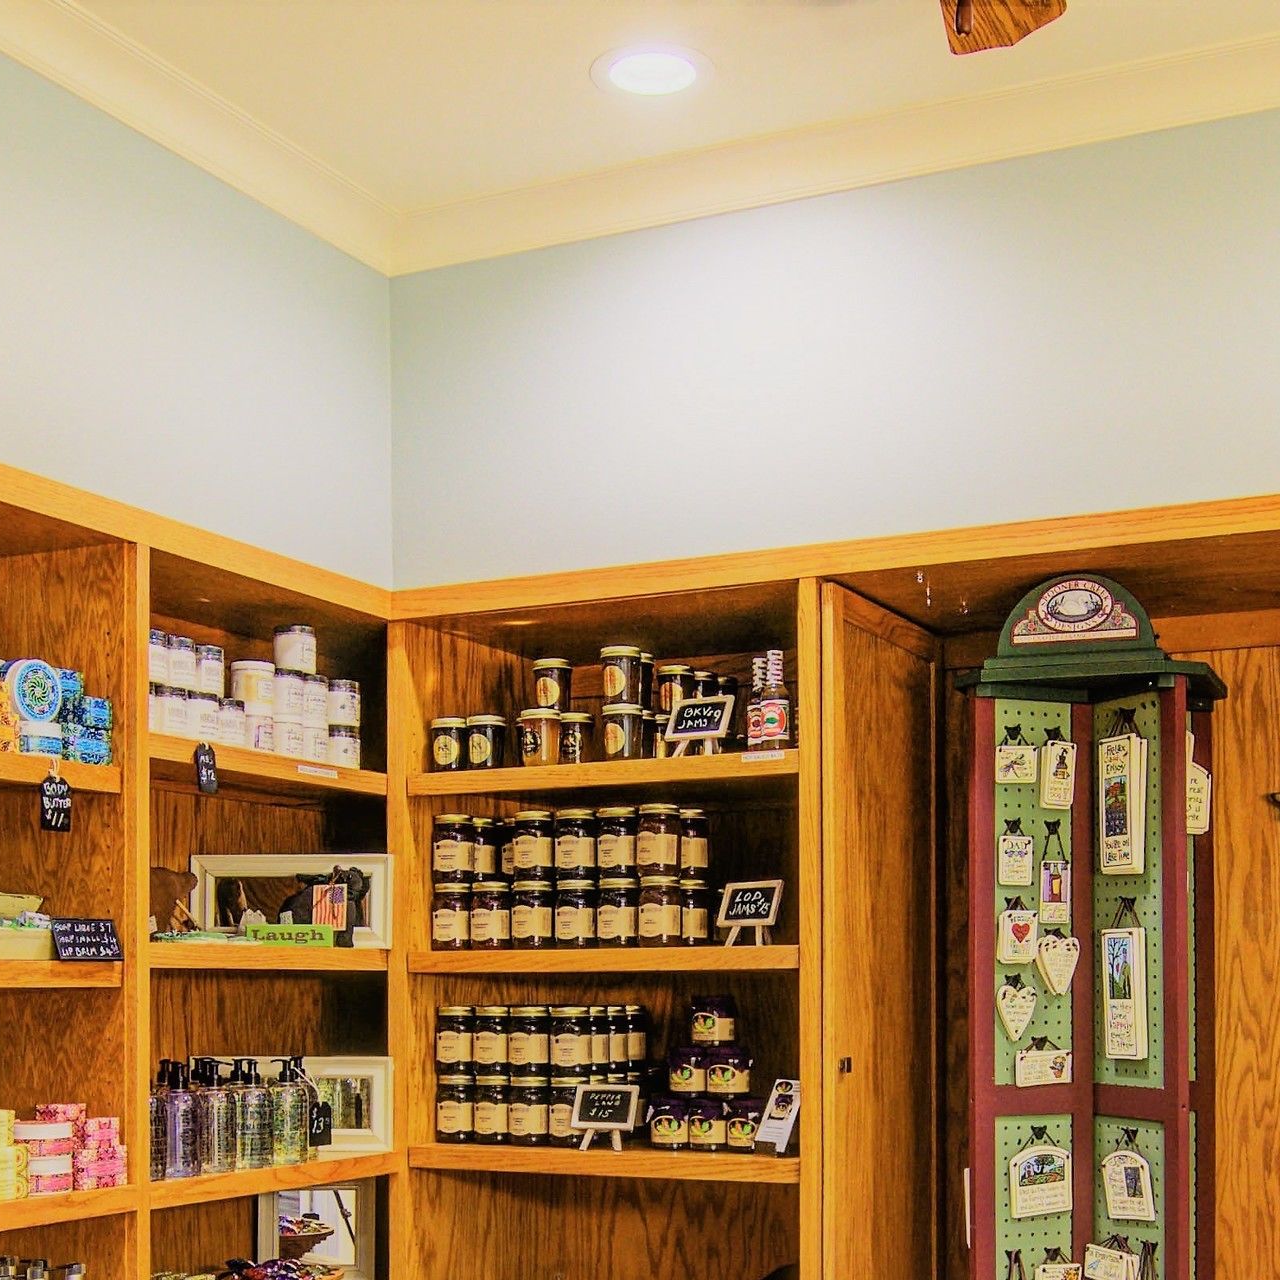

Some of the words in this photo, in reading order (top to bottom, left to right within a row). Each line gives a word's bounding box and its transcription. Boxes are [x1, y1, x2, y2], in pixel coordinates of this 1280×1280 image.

[1053, 618, 1099, 632] DESIGNS
[677, 718, 708, 730] JAMS
[734, 891, 763, 903] LOP
[729, 903, 757, 916] JAMS
[250, 929, 325, 944] Laugh
[589, 1107, 614, 1118] $15
